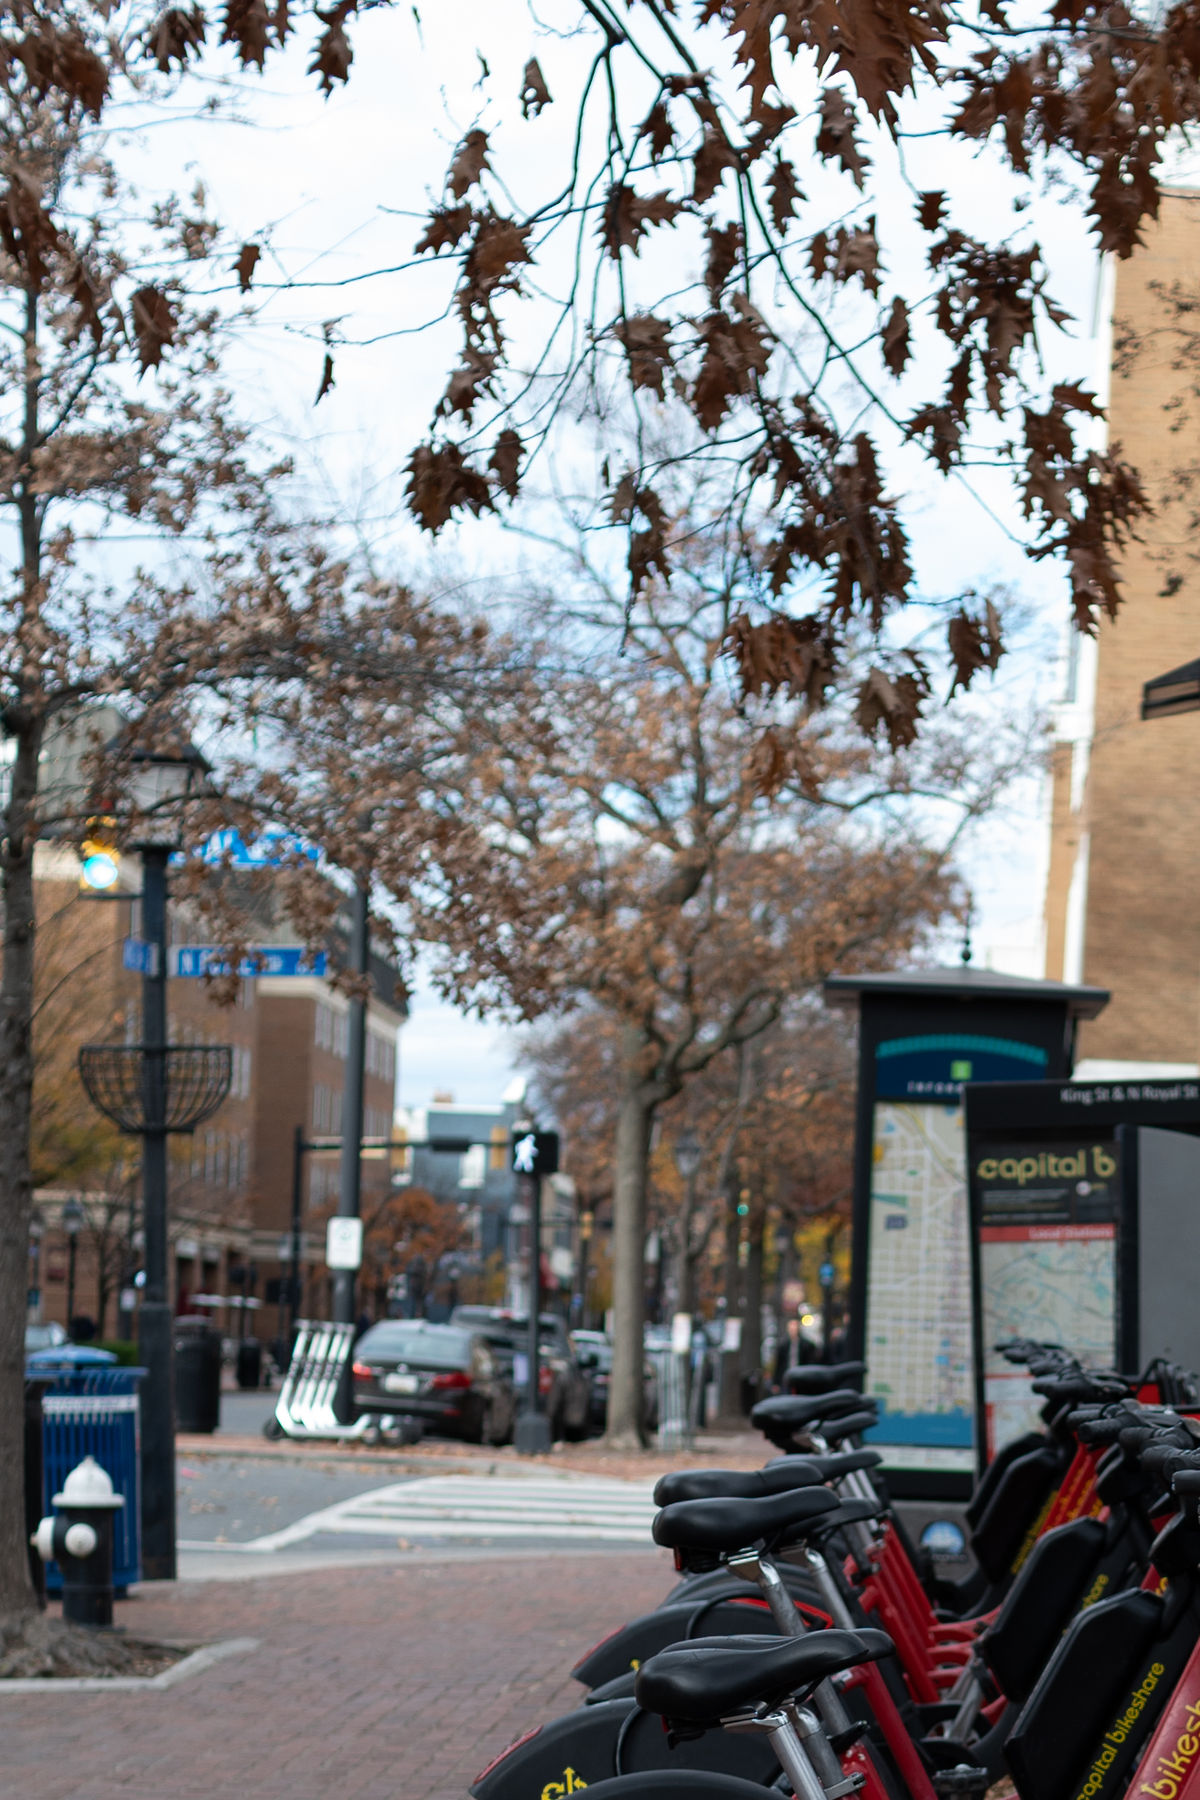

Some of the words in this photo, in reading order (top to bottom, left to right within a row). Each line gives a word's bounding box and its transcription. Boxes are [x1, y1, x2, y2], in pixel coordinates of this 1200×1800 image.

[1060, 1088, 1093, 1106] King
[1094, 1086, 1109, 1101] St
[1112, 1085, 1124, 1101] &
[1127, 1086, 1140, 1101] N
[1142, 1084, 1181, 1103] Royal
[1182, 1083, 1198, 1098] St
[977, 1151, 1086, 1186] capital
[1105, 1662, 1165, 1743] bikeshare
